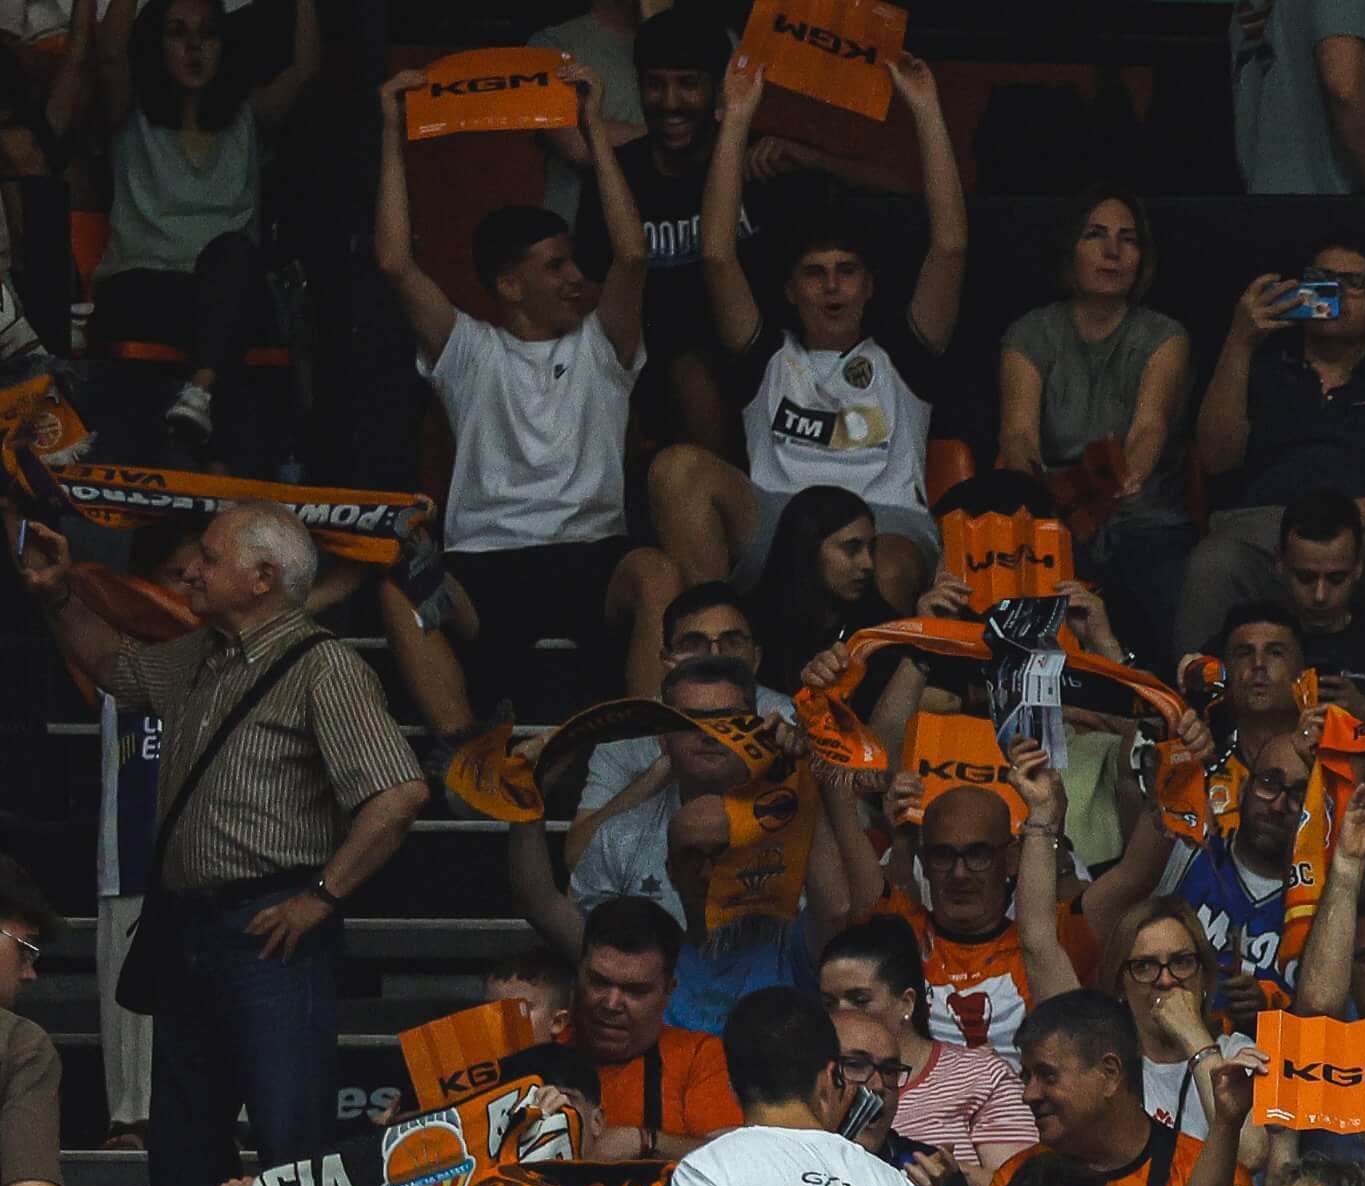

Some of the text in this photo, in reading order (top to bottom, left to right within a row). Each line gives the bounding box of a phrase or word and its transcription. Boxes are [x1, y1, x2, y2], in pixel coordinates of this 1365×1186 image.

[774, 14, 877, 64] KGM
[430, 72, 550, 97] KGM
[783, 408, 824, 437] TM
[916, 758, 1007, 783] KG
[437, 1059, 501, 1099] KG
